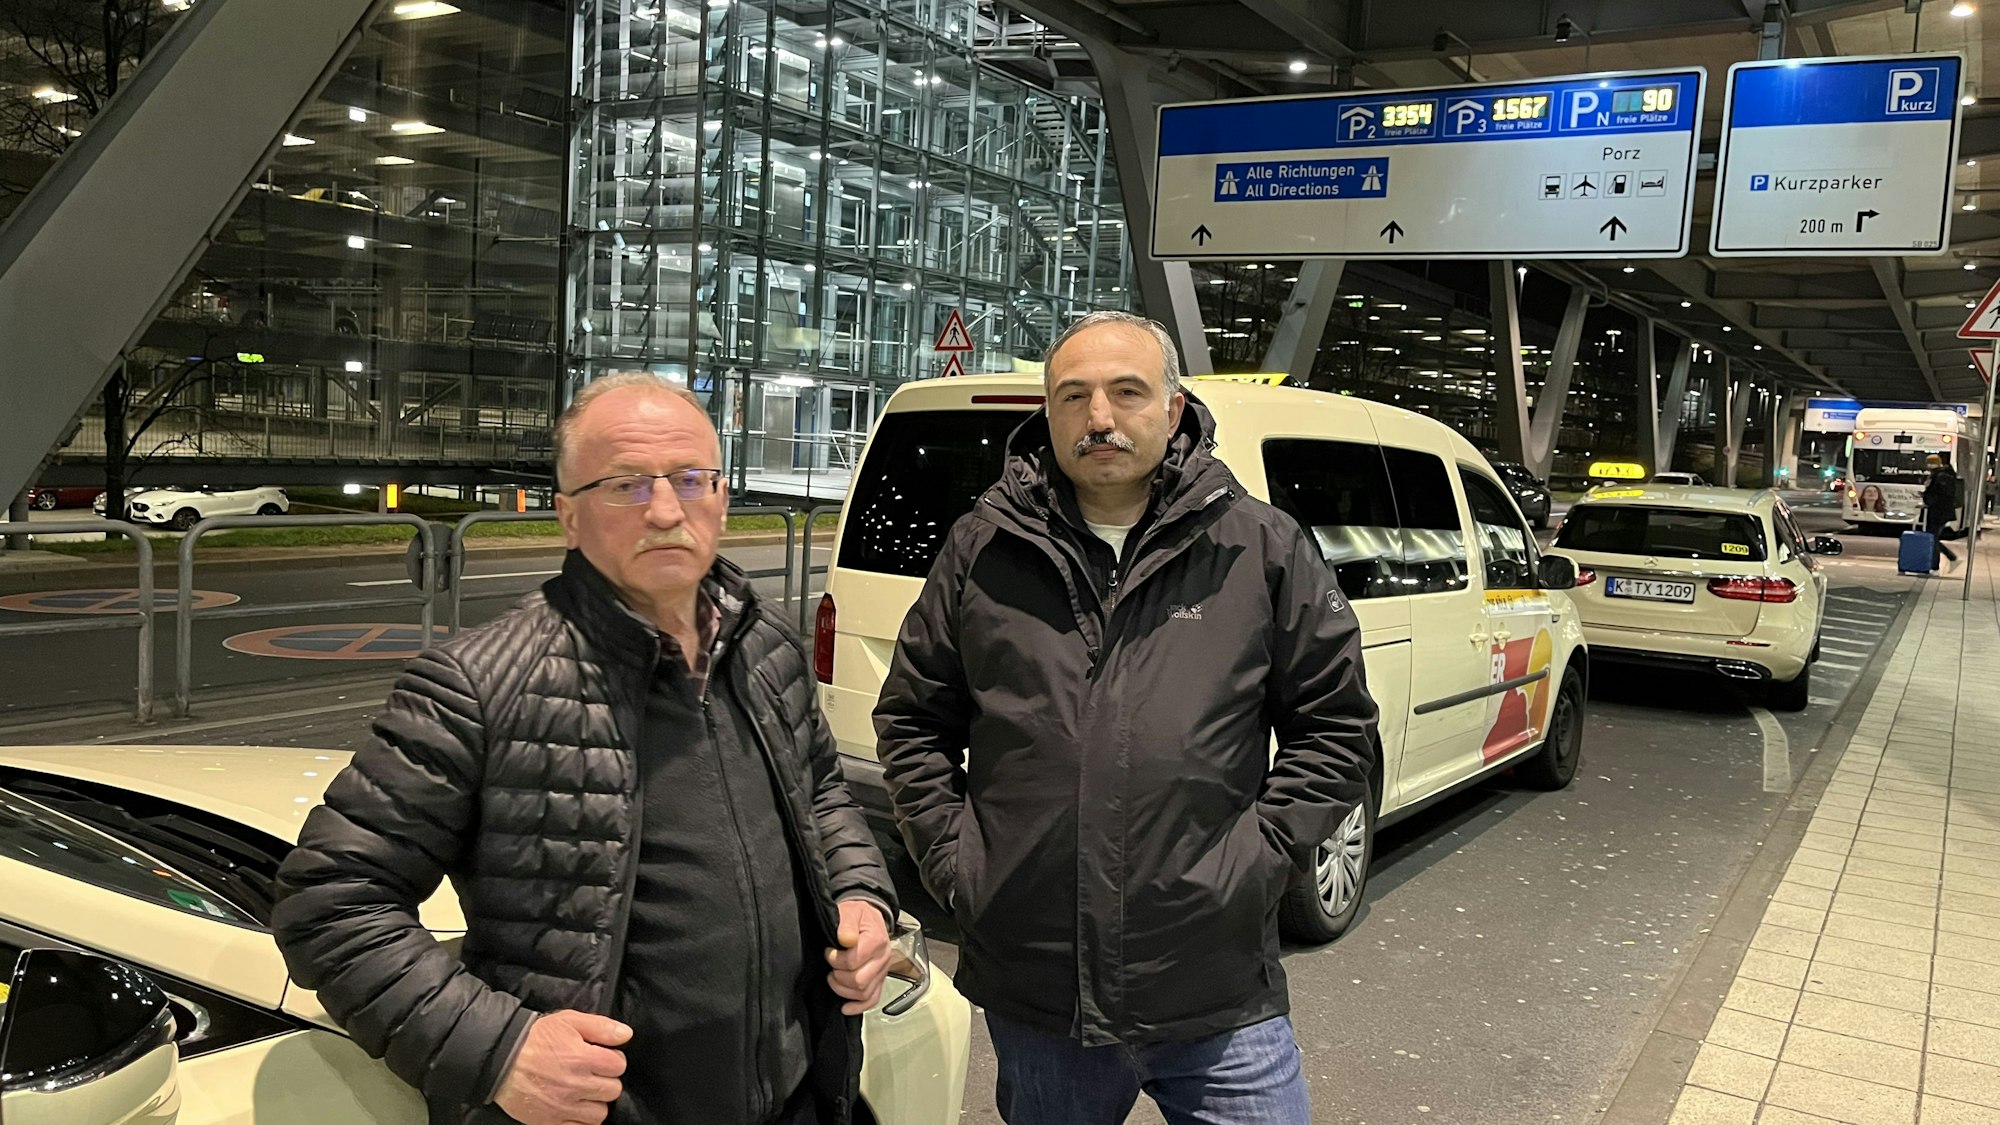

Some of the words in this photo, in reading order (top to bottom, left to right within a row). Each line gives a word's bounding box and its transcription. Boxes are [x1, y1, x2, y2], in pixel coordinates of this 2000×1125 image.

[1642, 89, 1673, 112] 90
[1901, 100, 1932, 111] kurz
[1382, 104, 1432, 127] 3354
[1492, 97, 1547, 120] 1567
[1496, 122, 1514, 131] freie
[1517, 121, 1542, 130] Plätze
[1617, 115, 1637, 124] freie
[1641, 113, 1668, 122] Plätze
[1602, 147, 1641, 160] Porz
[1246, 166, 1273, 179] Alle
[1279, 164, 1355, 179] Richtungen
[1245, 184, 1263, 197] All
[1269, 182, 1339, 197] Directions
[1753, 176, 1766, 189] P
[1774, 175, 1883, 193] Kurzparker
[1800, 219, 1825, 233] 200
[1831, 222, 1843, 233] m
[1723, 544, 1748, 554] 1209
[1616, 580, 1625, 593] K
[1634, 581, 1652, 596] TX
[1656, 583, 1692, 598] 1209
